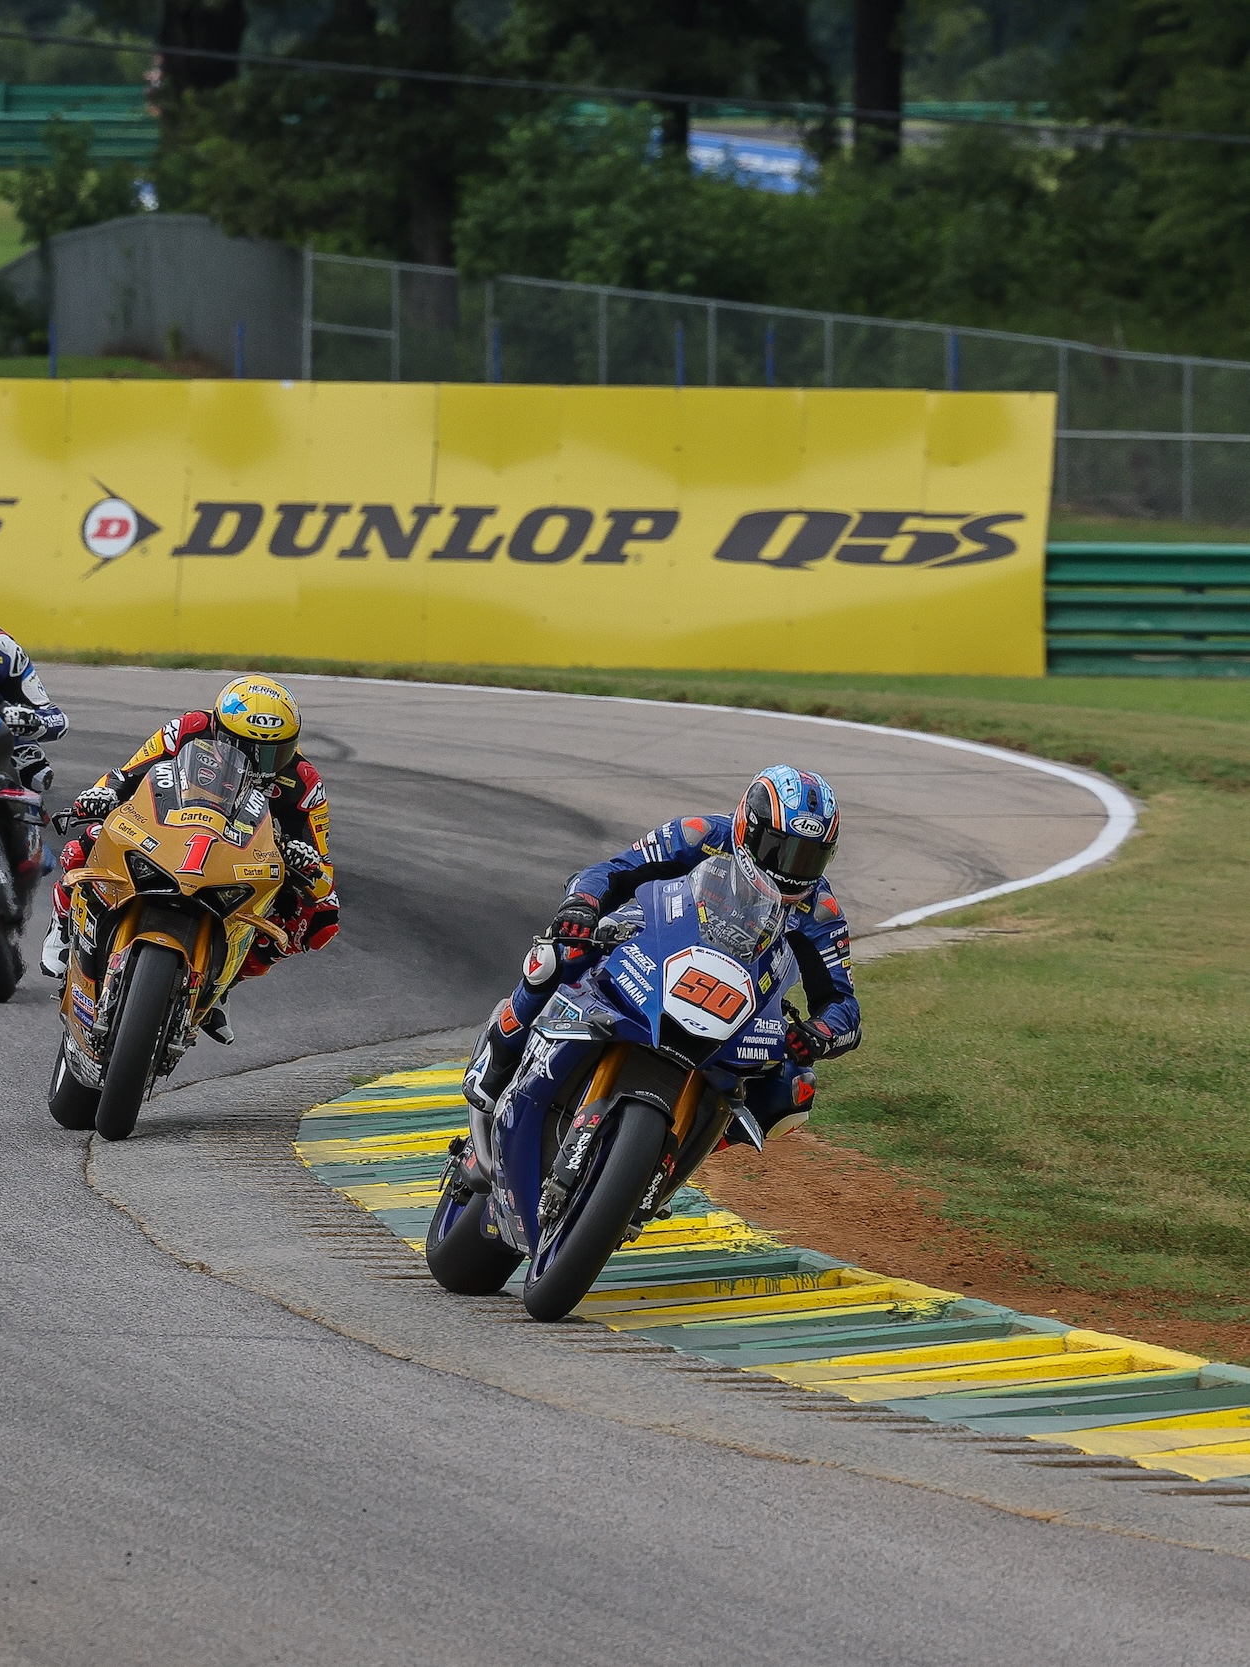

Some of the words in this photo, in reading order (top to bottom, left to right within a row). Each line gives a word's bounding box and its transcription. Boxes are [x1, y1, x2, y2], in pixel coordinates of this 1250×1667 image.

[169, 501, 681, 565] DUNLOP
[248, 685, 281, 700] HERRIN
[155, 763, 174, 788] KATO
[245, 789, 266, 818] KATO
[118, 822, 137, 838] Carter
[141, 838, 156, 850] CAT
[180, 812, 214, 824] Carter
[224, 825, 239, 842] CAT
[797, 819, 822, 834] Arai
[174, 833, 219, 876] 1
[243, 867, 263, 876] Carter
[621, 943, 657, 976] Attack
[705, 951, 743, 974] MOTOAMERICA
[616, 972, 648, 1007] YAMAHA
[619, 959, 654, 993] PROGRESSIVE
[669, 966, 749, 1025] 50
[742, 1036, 778, 1046] PROGRESSIVE
[754, 1018, 785, 1036] Attack
[736, 1047, 770, 1060] YAMAHA
